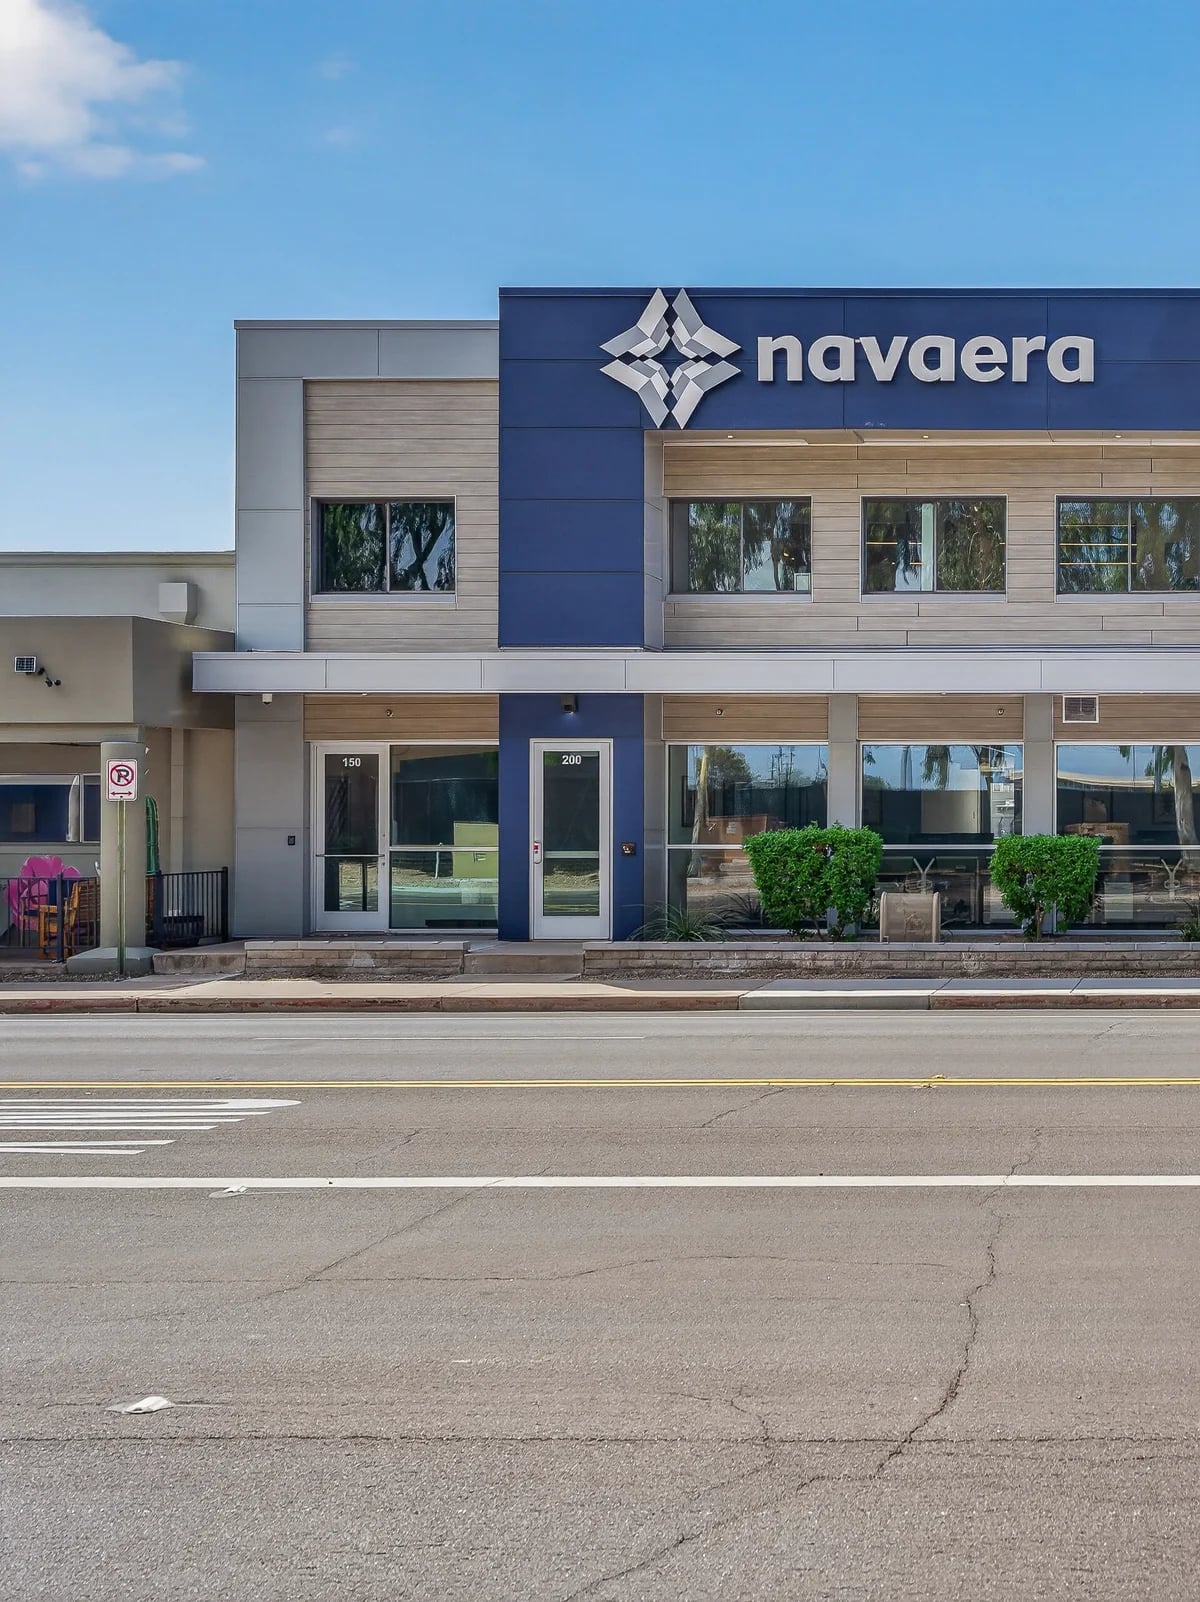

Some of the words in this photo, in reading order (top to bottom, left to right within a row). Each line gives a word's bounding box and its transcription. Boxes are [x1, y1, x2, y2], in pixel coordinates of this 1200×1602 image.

[757, 335, 1095, 383] navaera
[342, 757, 361, 767] 150
[561, 755, 582, 765] 200
